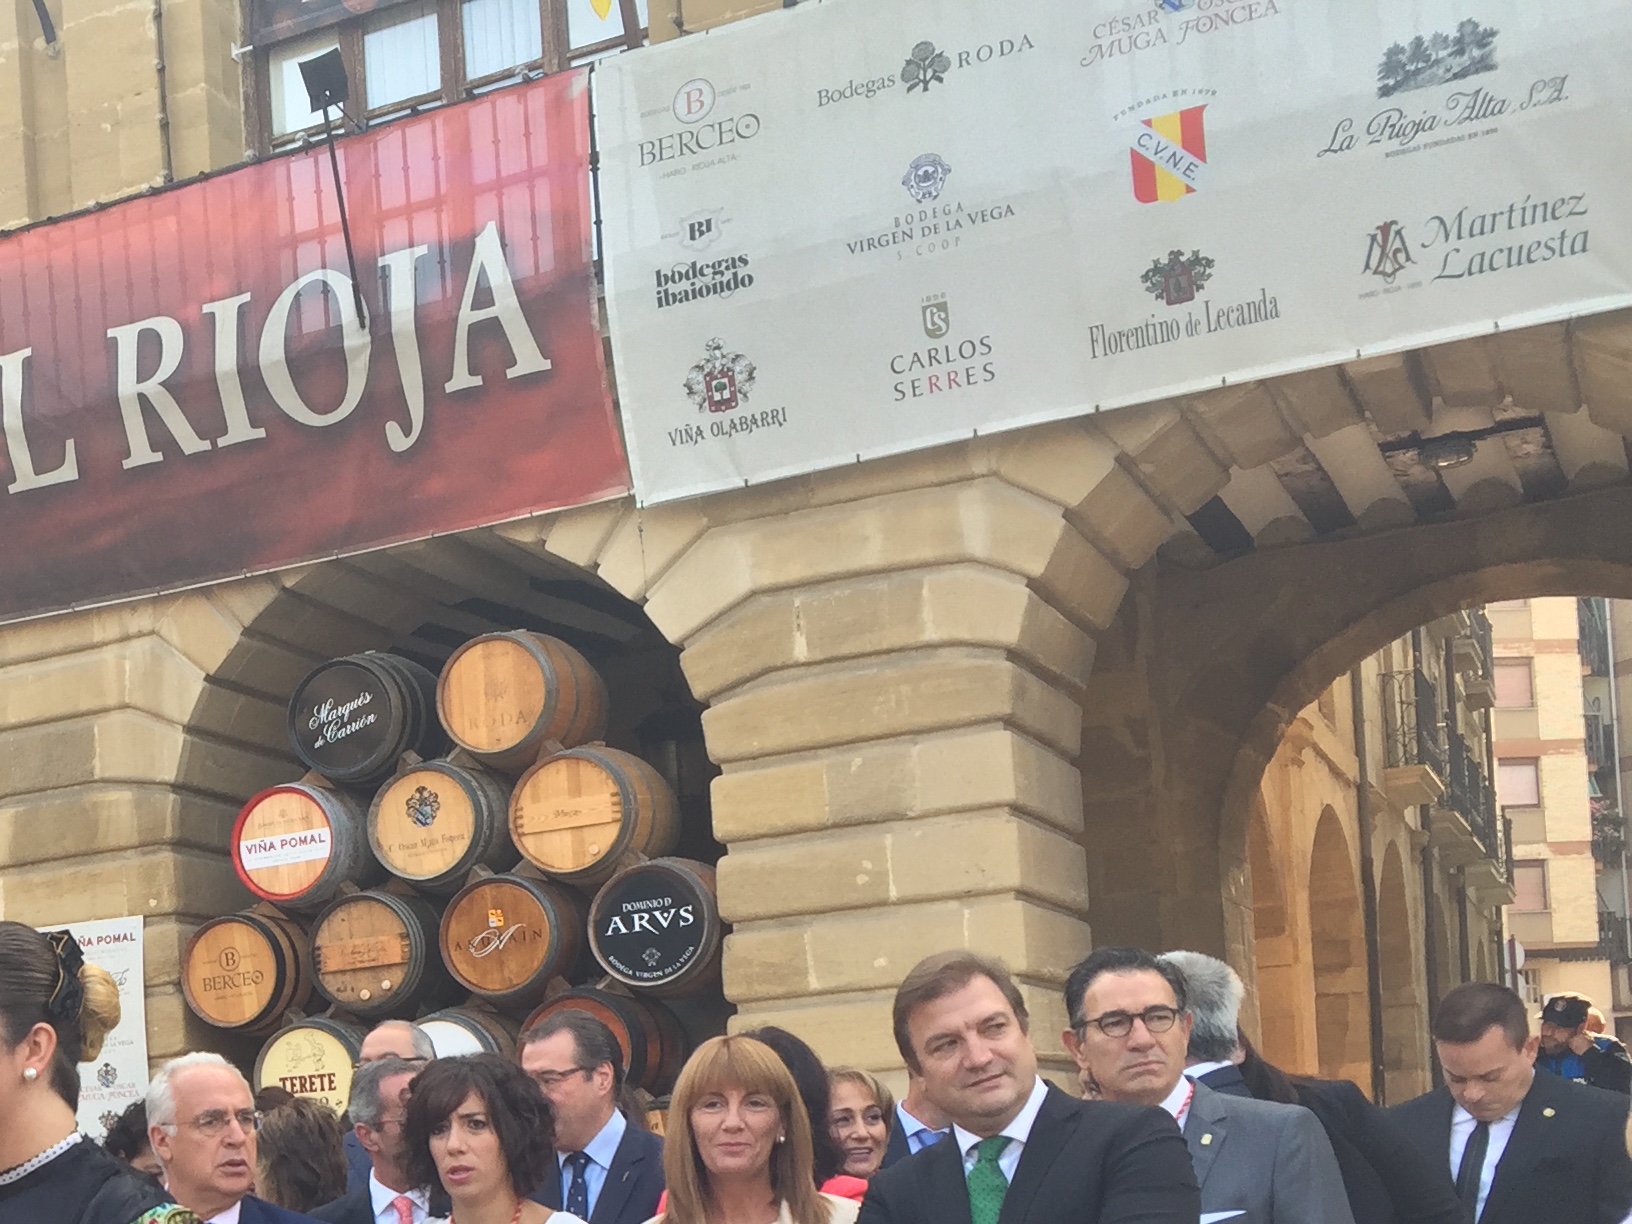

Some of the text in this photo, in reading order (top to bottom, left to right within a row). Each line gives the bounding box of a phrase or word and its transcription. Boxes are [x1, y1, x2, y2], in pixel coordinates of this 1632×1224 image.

[1080, 0, 1281, 67] MUGA FONCEA
[1092, 9, 1160, 40] CÉSAR
[817, 34, 1034, 107] Bodegas RODA
[638, 113, 760, 168] BERCEO
[1317, 117, 1360, 158] La
[1366, 108, 1442, 145] Rioja
[1137, 132, 1198, 181] C.V.N.E.
[846, 204, 1015, 255] VIRGEN DE LA VEGA
[894, 202, 964, 228] BODEGA
[1421, 192, 1589, 248] Martínez
[655, 254, 750, 288] bodegas
[1431, 228, 1590, 284] Lacuesta
[656, 272, 754, 309] ibaiondo
[1088, 288, 1280, 359] Florentino de Lecanda
[107, 221, 551, 470] RIOJA
[890, 335, 992, 375] CARLOS
[893, 362, 996, 402] SERRES
[668, 407, 787, 446] VIÑA OLABARRI
[309, 692, 373, 731] Marqués
[323, 712, 378, 743] Carrión
[246, 833, 326, 854] VIÑA POMAL
[622, 899, 663, 913] DOMINIO
[78, 932, 136, 946] ÑA POMAL
[202, 970, 264, 992] BERCEO
[279, 1073, 336, 1094] TERETE
